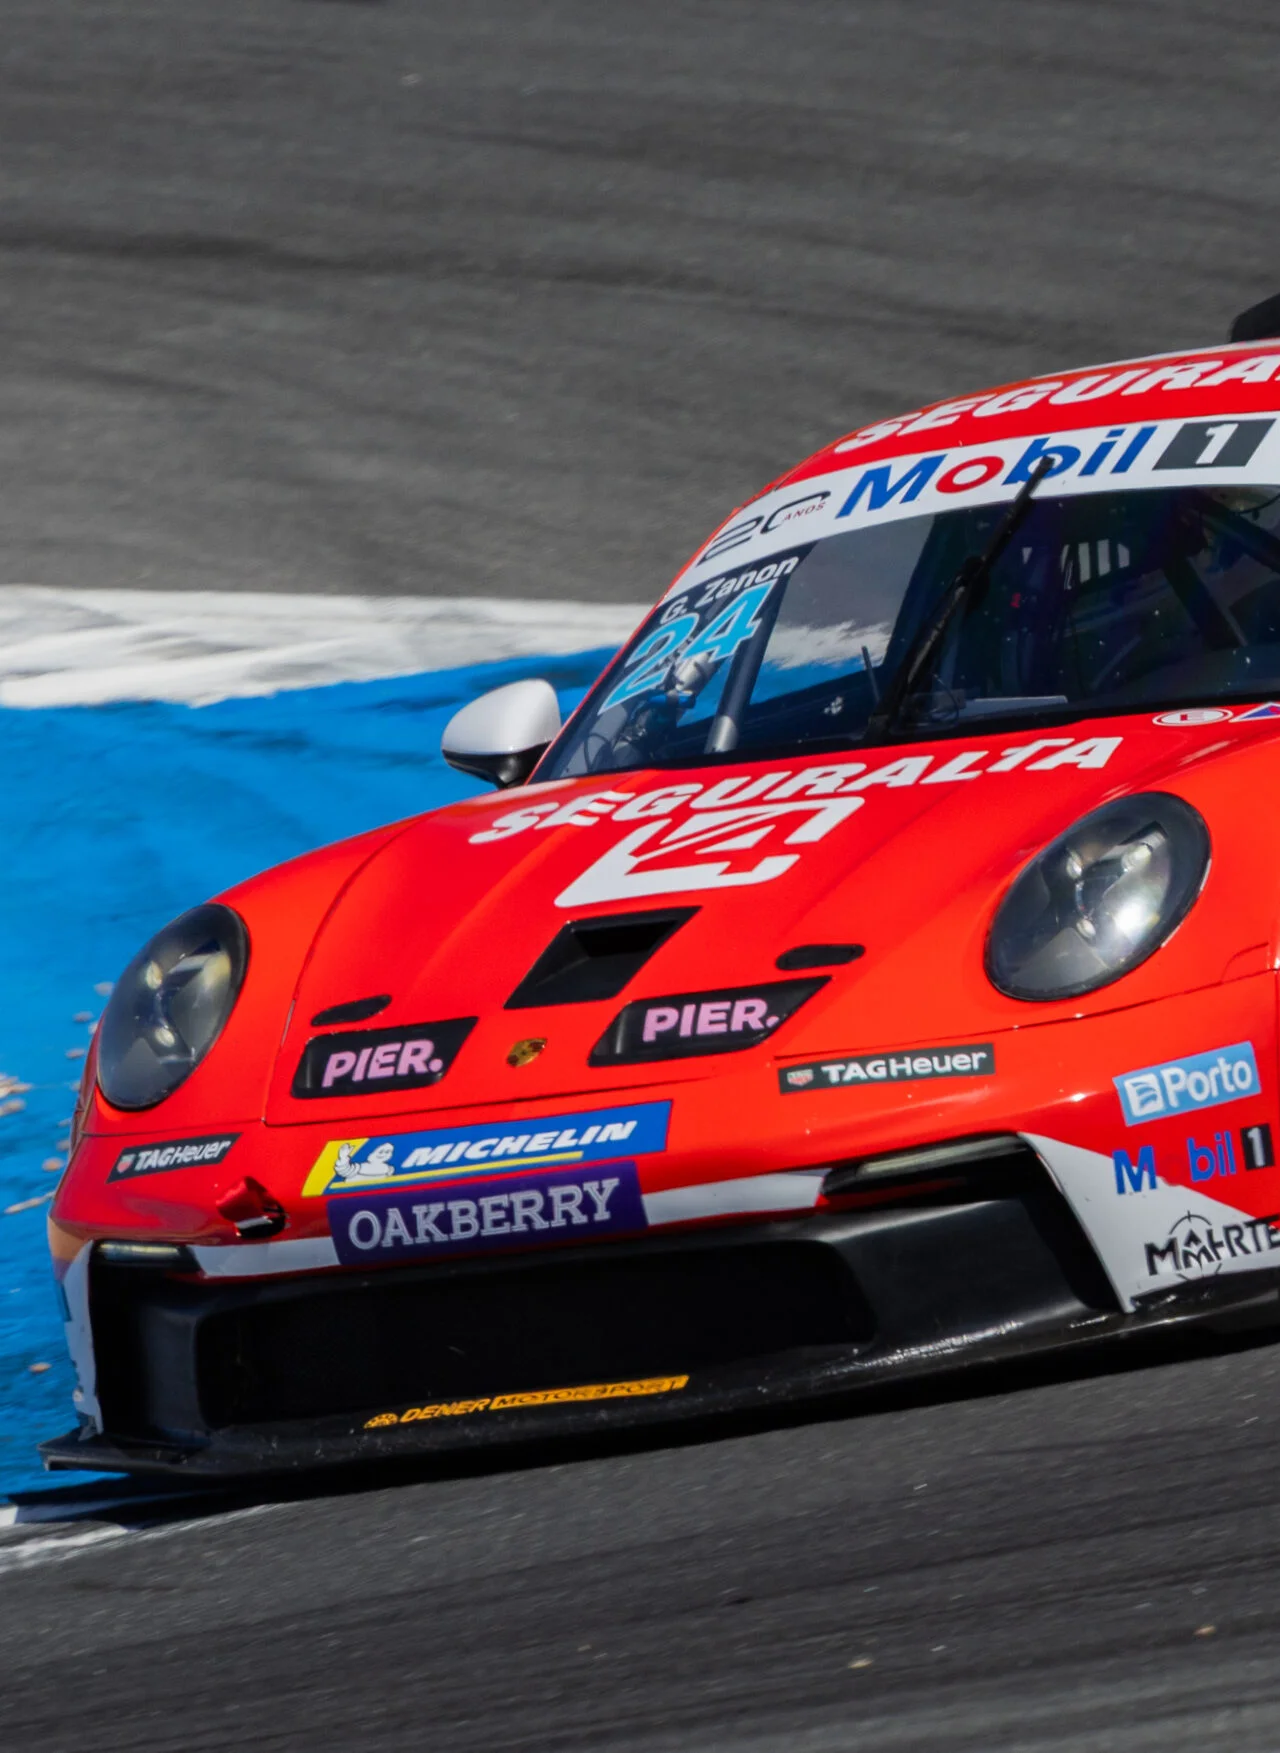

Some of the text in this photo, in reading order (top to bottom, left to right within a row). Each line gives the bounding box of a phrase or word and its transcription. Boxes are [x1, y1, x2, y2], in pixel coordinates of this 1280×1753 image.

[835, 423, 1224, 518] Mobil 1
[660, 556, 799, 625] G. Zanon
[597, 578, 778, 716] 24
[468, 735, 1123, 845] SEGURALTA
[642, 998, 781, 1042] PIER.
[321, 1039, 445, 1088] PIER.
[1160, 1056, 1252, 1108] Porto
[400, 1119, 638, 1168] MICHELIN
[1247, 1127, 1266, 1168] 1
[349, 1178, 620, 1251] OAKBERRY
[400, 1376, 686, 1423] DENER MOTORSPORT
